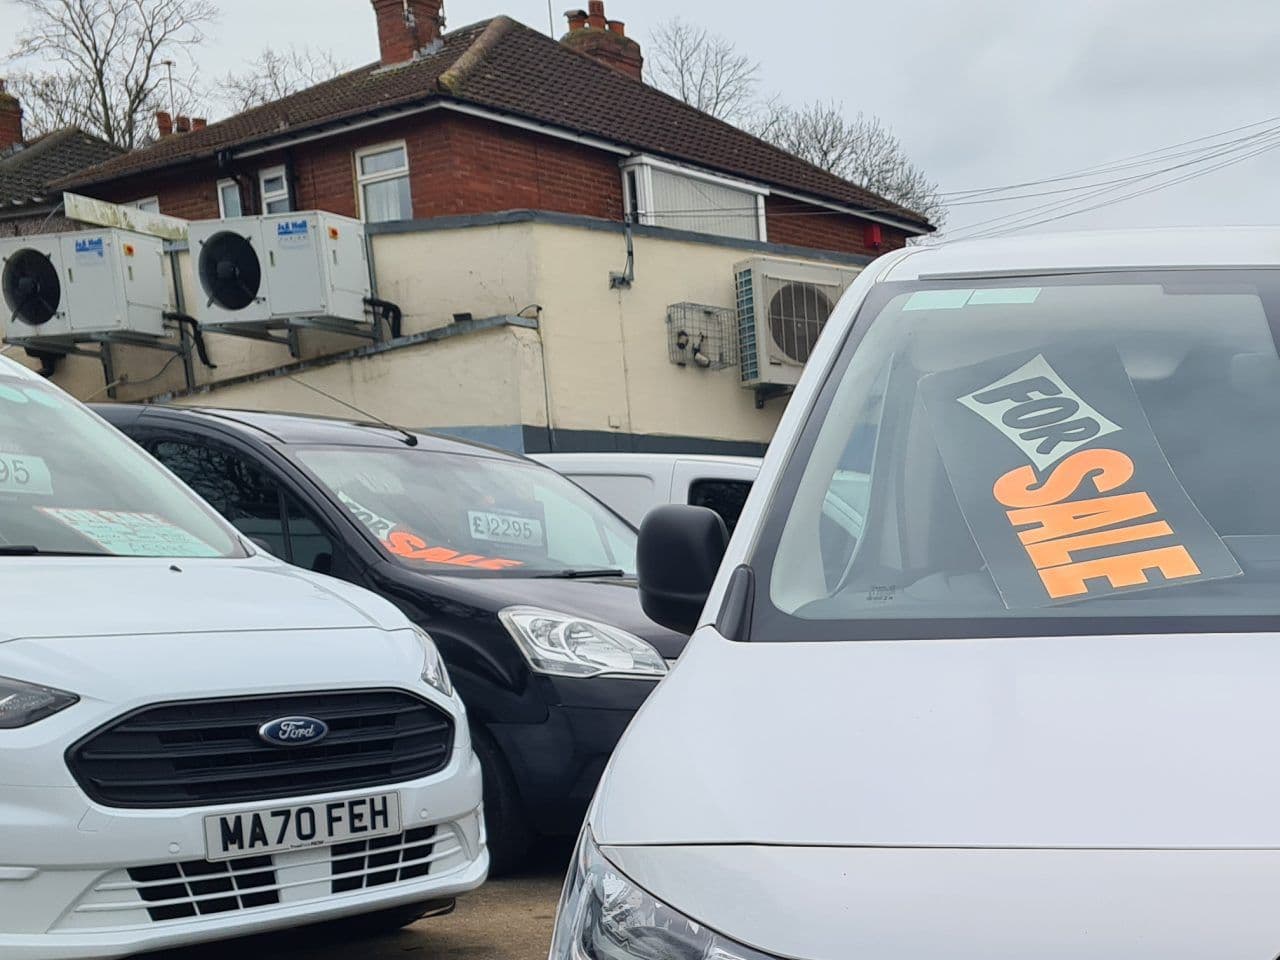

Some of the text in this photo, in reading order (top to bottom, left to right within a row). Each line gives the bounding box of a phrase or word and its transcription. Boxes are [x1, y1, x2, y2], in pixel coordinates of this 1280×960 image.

[972, 375, 1102, 456] FOR
[992, 447, 1202, 599] SALE
[278, 721, 316, 740] Ford
[219, 795, 389, 852] MA70 FEH
